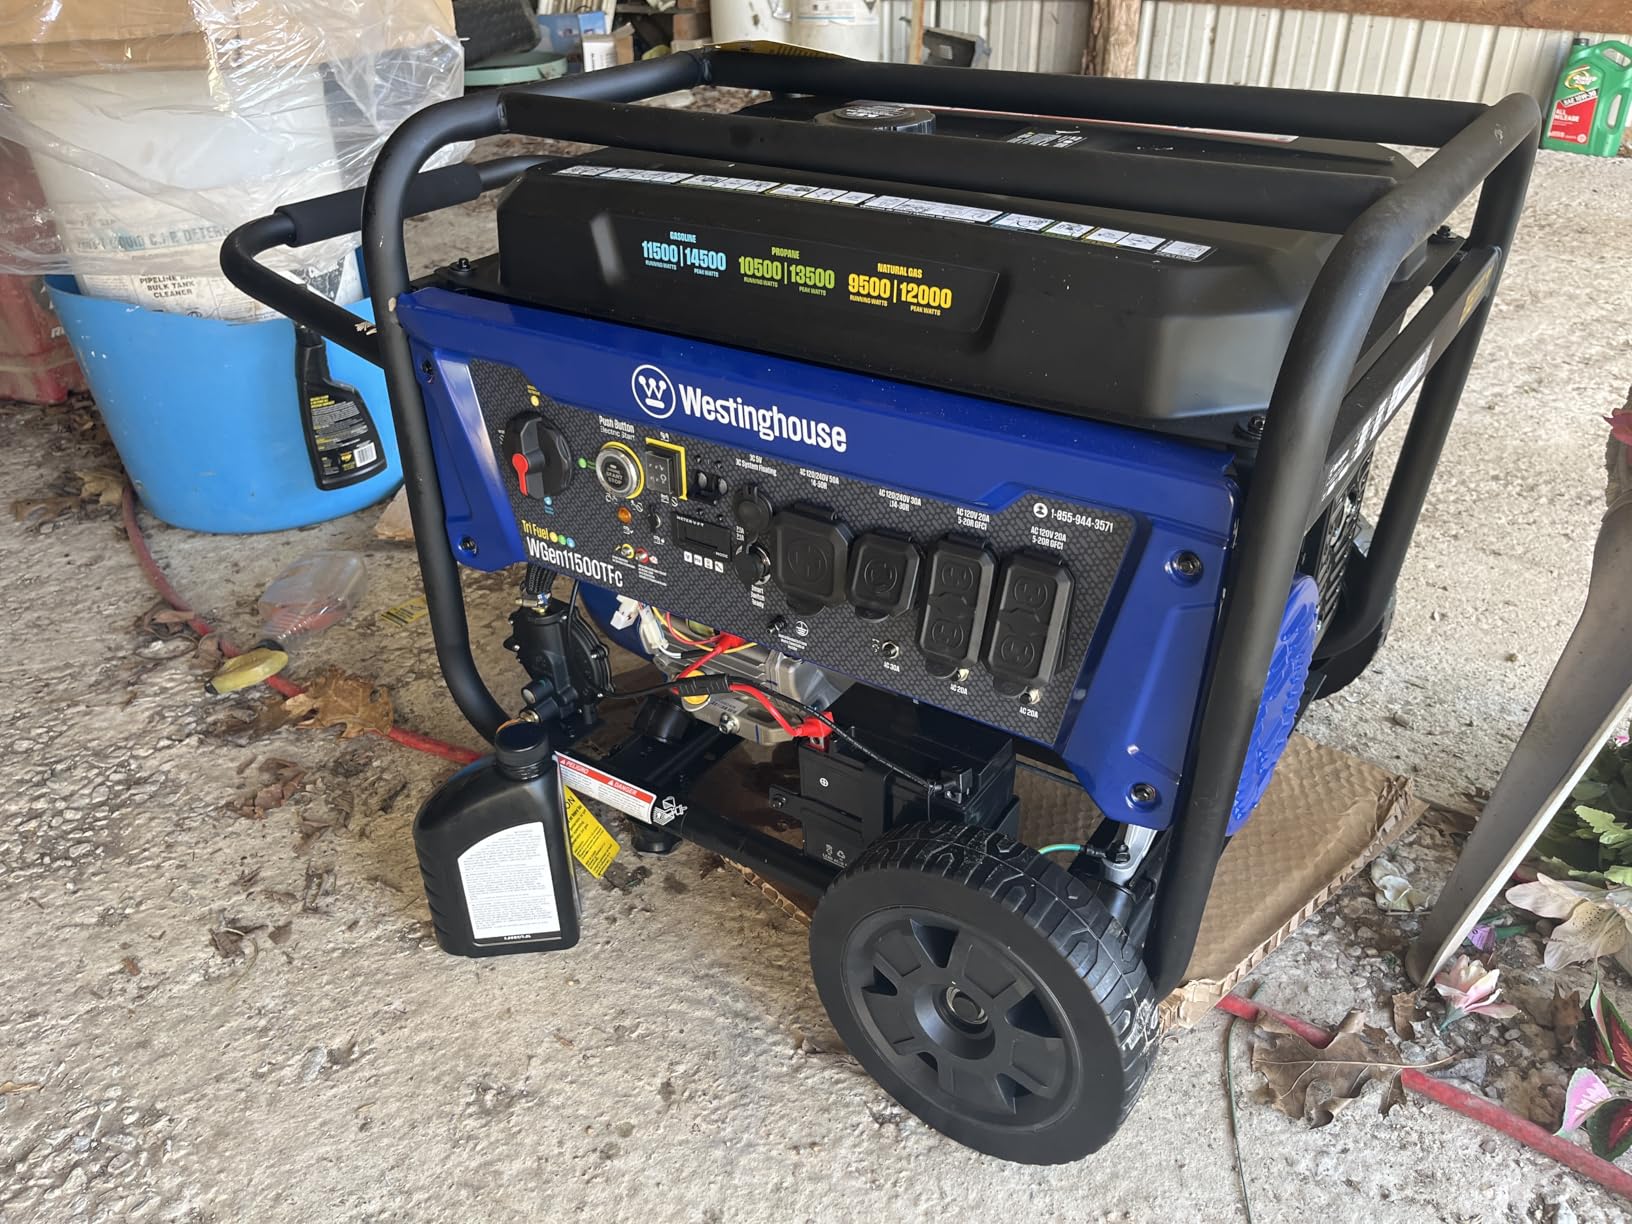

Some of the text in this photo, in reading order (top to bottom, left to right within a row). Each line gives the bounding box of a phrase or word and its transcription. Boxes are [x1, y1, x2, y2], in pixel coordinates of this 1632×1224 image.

[670, 231, 696, 243] GASOLINE
[642, 240, 727, 271] 11500 14500
[771, 247, 800, 260] PROPANE
[663, 262, 677, 270] WATTS
[739, 256, 835, 289] 10500 13500
[877, 263, 923, 279] NATURAL GAS
[139, 275, 177, 284] PIPELINE
[705, 270, 719, 278] WATTS
[171, 281, 195, 289] TANK
[744, 277, 778, 288] RUNNING WATTS
[153, 288, 193, 298] CLEANER
[811, 288, 827, 296] WATTS
[848, 273, 952, 309] 9500 12000
[849, 294, 888, 307] RUNNING WATTS
[910, 305, 941, 316] PEAK WATTS
[599, 415, 635, 433] Push Button
[678, 383, 847, 452] Westinghouse
[600, 425, 635, 440] Electric Start
[741, 459, 759, 471] System
[829, 475, 840, 485] 50A
[878, 488, 886, 497] AC
[910, 496, 922, 507] 30A
[956, 507, 990, 523] AC 120V 20A
[1051, 508, 1114, 533] 1-855-944-3571
[521, 519, 550, 540] Tri Fuel
[957, 517, 987, 531] 5-20R GFCI
[1030, 526, 1067, 543] AC 120V 20A
[1032, 535, 1064, 550] 5-20R GFCI
[889, 664, 900, 673] 30A
[957, 686, 968, 695] 20A
[1019, 706, 1039, 719] AC 20A
[566, 761, 589, 774] PELIGRO
[615, 781, 638, 795] DANGER
